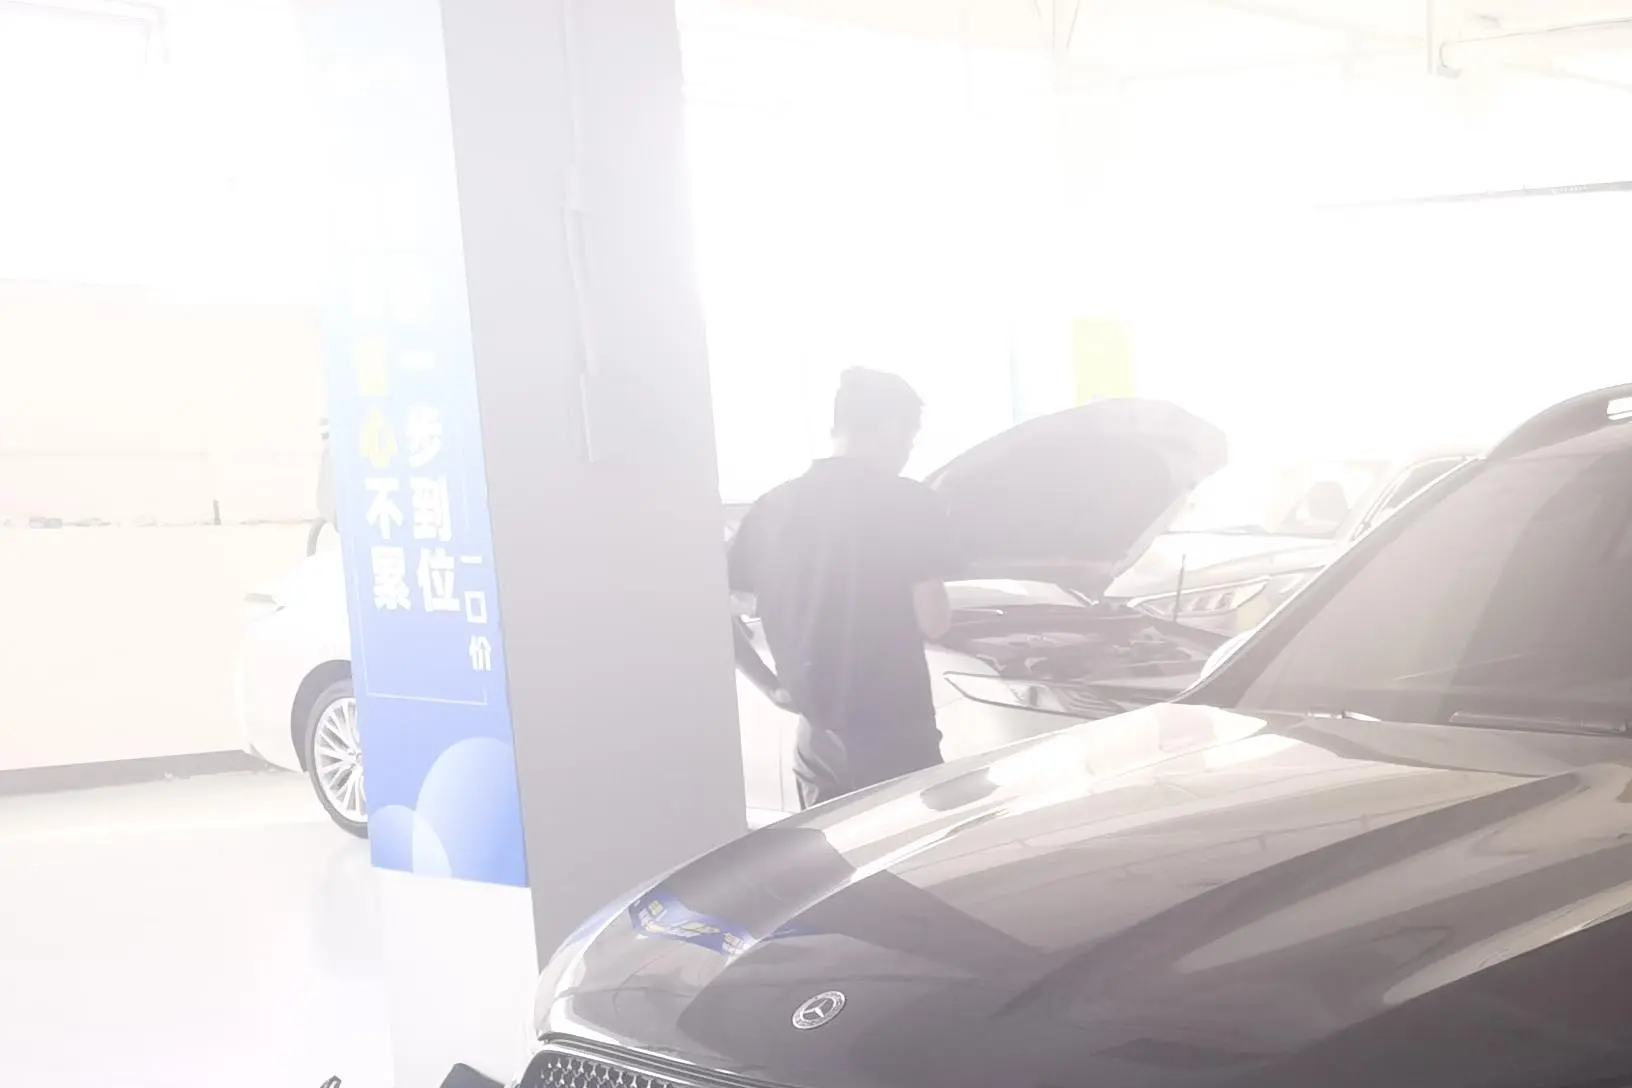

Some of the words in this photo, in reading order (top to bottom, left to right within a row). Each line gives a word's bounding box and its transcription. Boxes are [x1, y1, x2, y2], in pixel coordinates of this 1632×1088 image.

[355, 338, 411, 611] 心不累
[460, 555, 491, 671] 一口价
